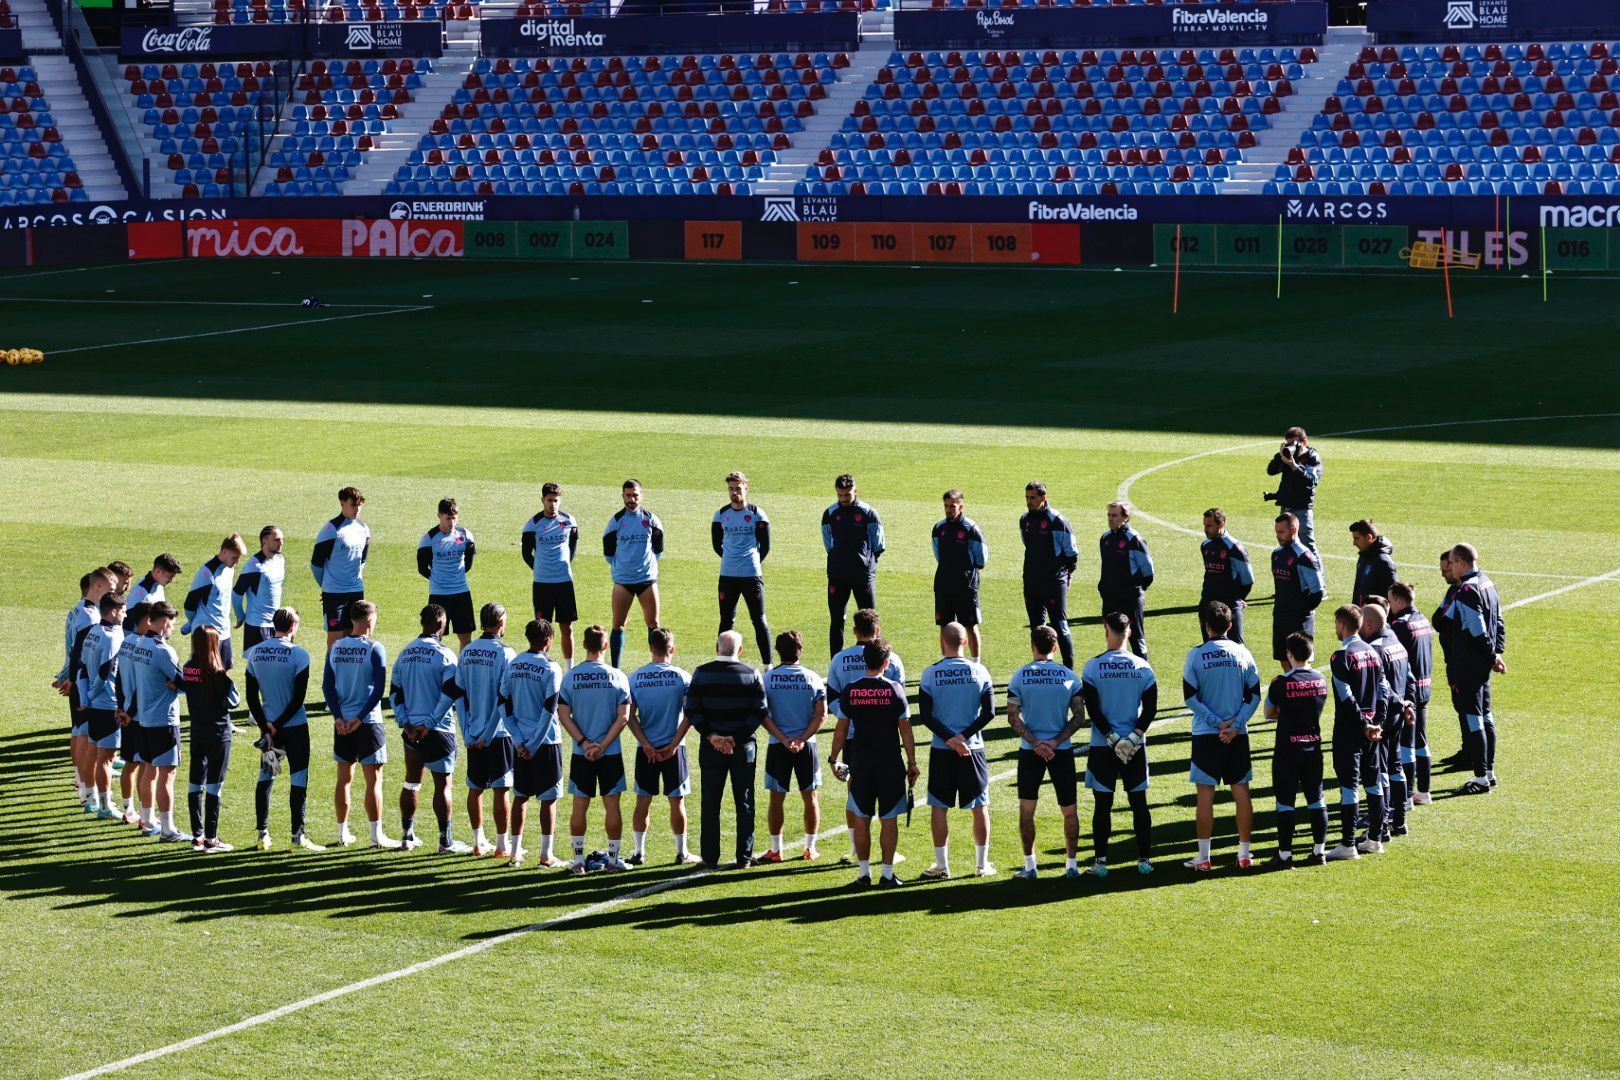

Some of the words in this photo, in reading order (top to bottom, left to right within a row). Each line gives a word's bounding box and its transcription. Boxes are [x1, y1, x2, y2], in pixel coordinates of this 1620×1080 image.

[1172, 8, 1268, 24] FibraValencia
[1479, 6, 1508, 15] BLAU
[1480, 15, 1508, 24] HOME
[520, 19, 575, 40] digital
[142, 27, 213, 52] Coca-Cola
[550, 31, 604, 46] menta
[413, 201, 484, 212] ENERDRINK
[803, 205, 837, 215] BLAU
[1028, 201, 1137, 220] FibraValencia
[1287, 200, 1387, 218] MARCOS
[1540, 205, 1620, 227] macr
[474, 232, 505, 247] 008
[529, 231, 560, 247] 007
[584, 231, 615, 247] 024
[702, 233, 725, 248] 117
[812, 234, 840, 249] 109
[871, 234, 896, 250] 110
[928, 235, 956, 250] 107
[987, 235, 1016, 251] 108
[1234, 237, 1260, 253] 011
[1294, 237, 1328, 254] 028
[1358, 237, 1392, 254] 027
[1558, 240, 1590, 257] 016
[255, 646, 292, 655] macron
[462, 649, 497, 659] macron
[511, 662, 545, 675] macron
[1022, 668, 1066, 677] macron
[1099, 662, 1136, 670] macro
[1203, 661, 1231, 669] LEVANTE
[573, 672, 614, 681] macron
[636, 670, 678, 680] macron
[1286, 679, 1327, 690] macron
[851, 688, 892, 697] macron
